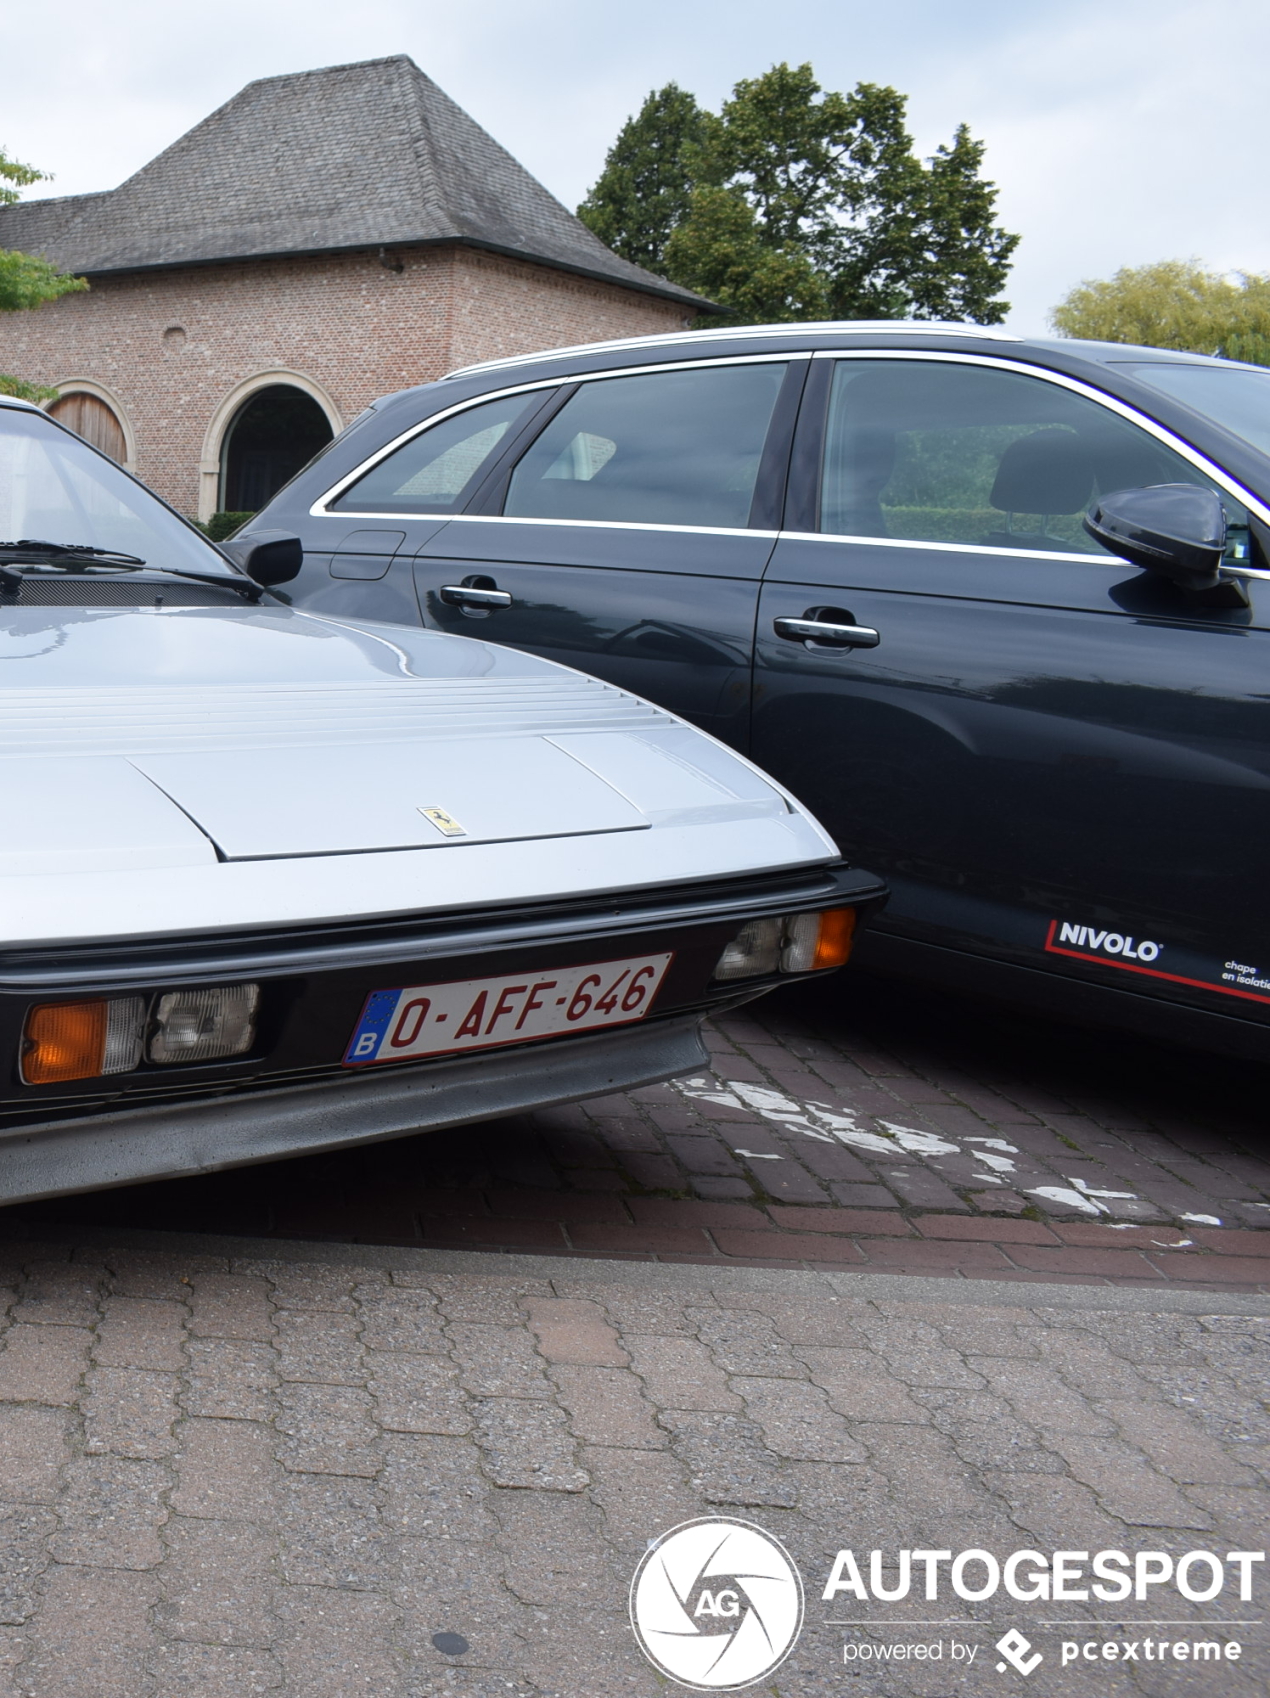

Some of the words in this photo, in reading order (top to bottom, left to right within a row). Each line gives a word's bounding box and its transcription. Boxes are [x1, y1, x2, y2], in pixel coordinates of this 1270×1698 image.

[1059, 922, 1160, 962] NIVOLO
[1221, 972, 1235, 981] en
[1224, 960, 1257, 975] chape
[355, 1033, 377, 1056] B
